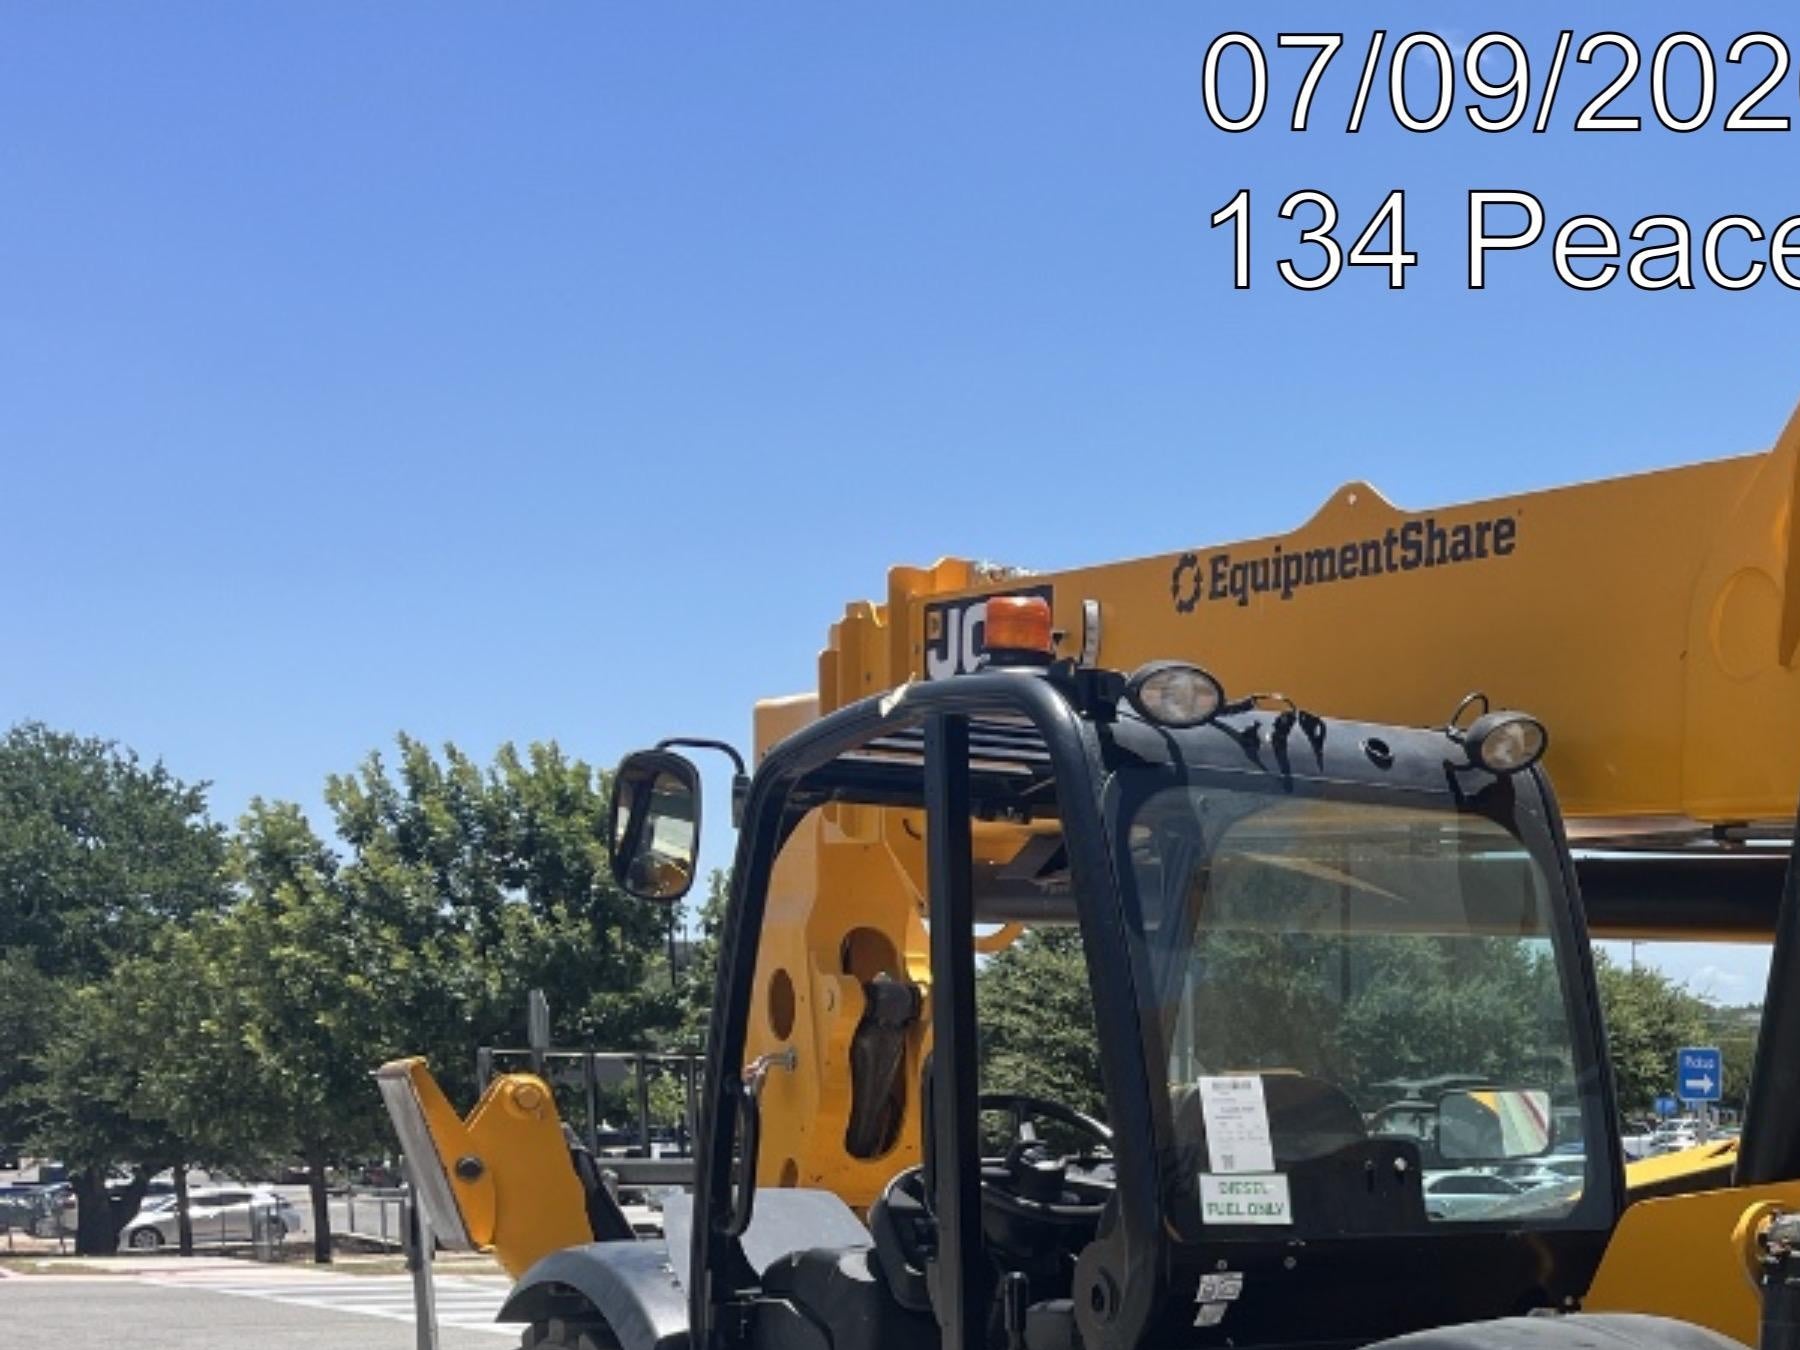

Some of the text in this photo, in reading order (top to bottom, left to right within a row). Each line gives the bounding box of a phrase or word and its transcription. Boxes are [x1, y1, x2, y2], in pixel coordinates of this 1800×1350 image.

[1209, 516, 1515, 606] EquipmentShare
[1219, 1182, 1269, 1196] DIESEL
[1207, 1202, 1285, 1217] FUEL ONLY
